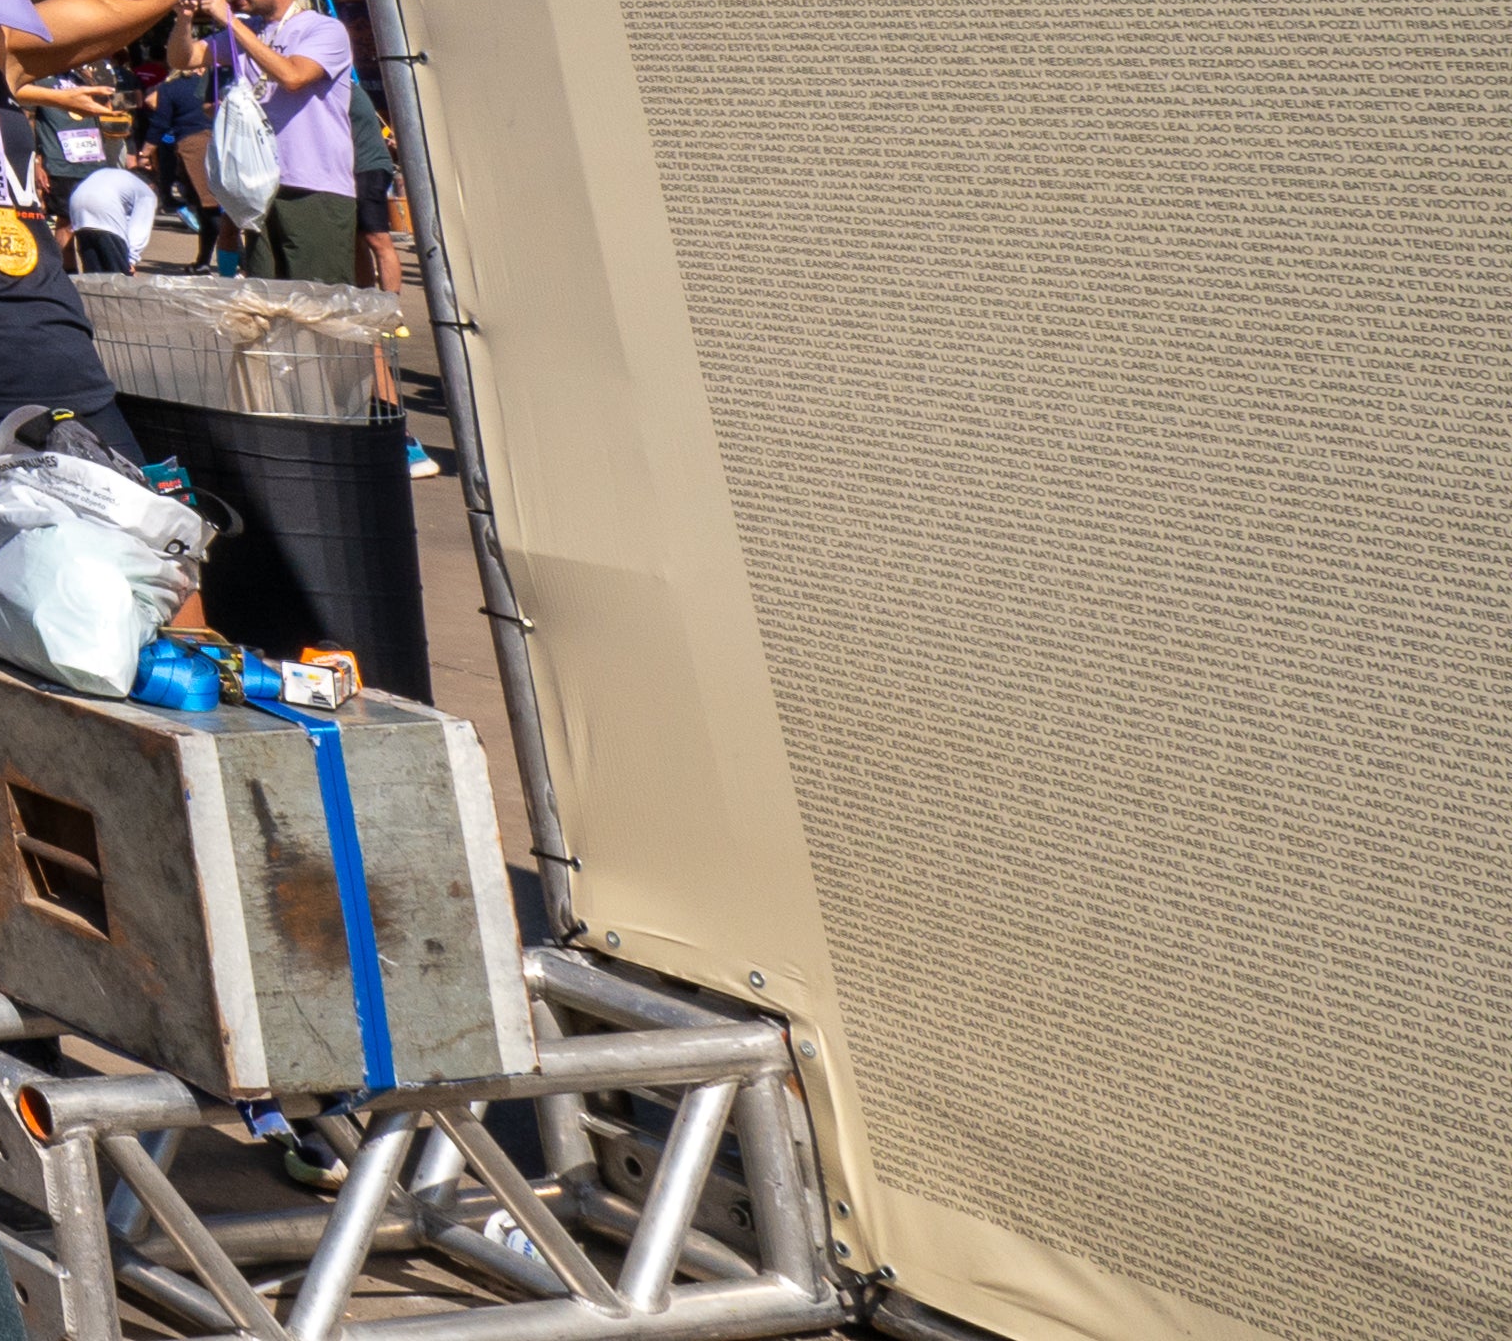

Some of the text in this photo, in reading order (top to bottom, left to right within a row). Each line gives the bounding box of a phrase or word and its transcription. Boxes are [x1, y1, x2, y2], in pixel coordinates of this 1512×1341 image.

[1328, 342, 1452, 363] LETICIA ALCARAZ
[1410, 391, 1459, 405] LUCAS
